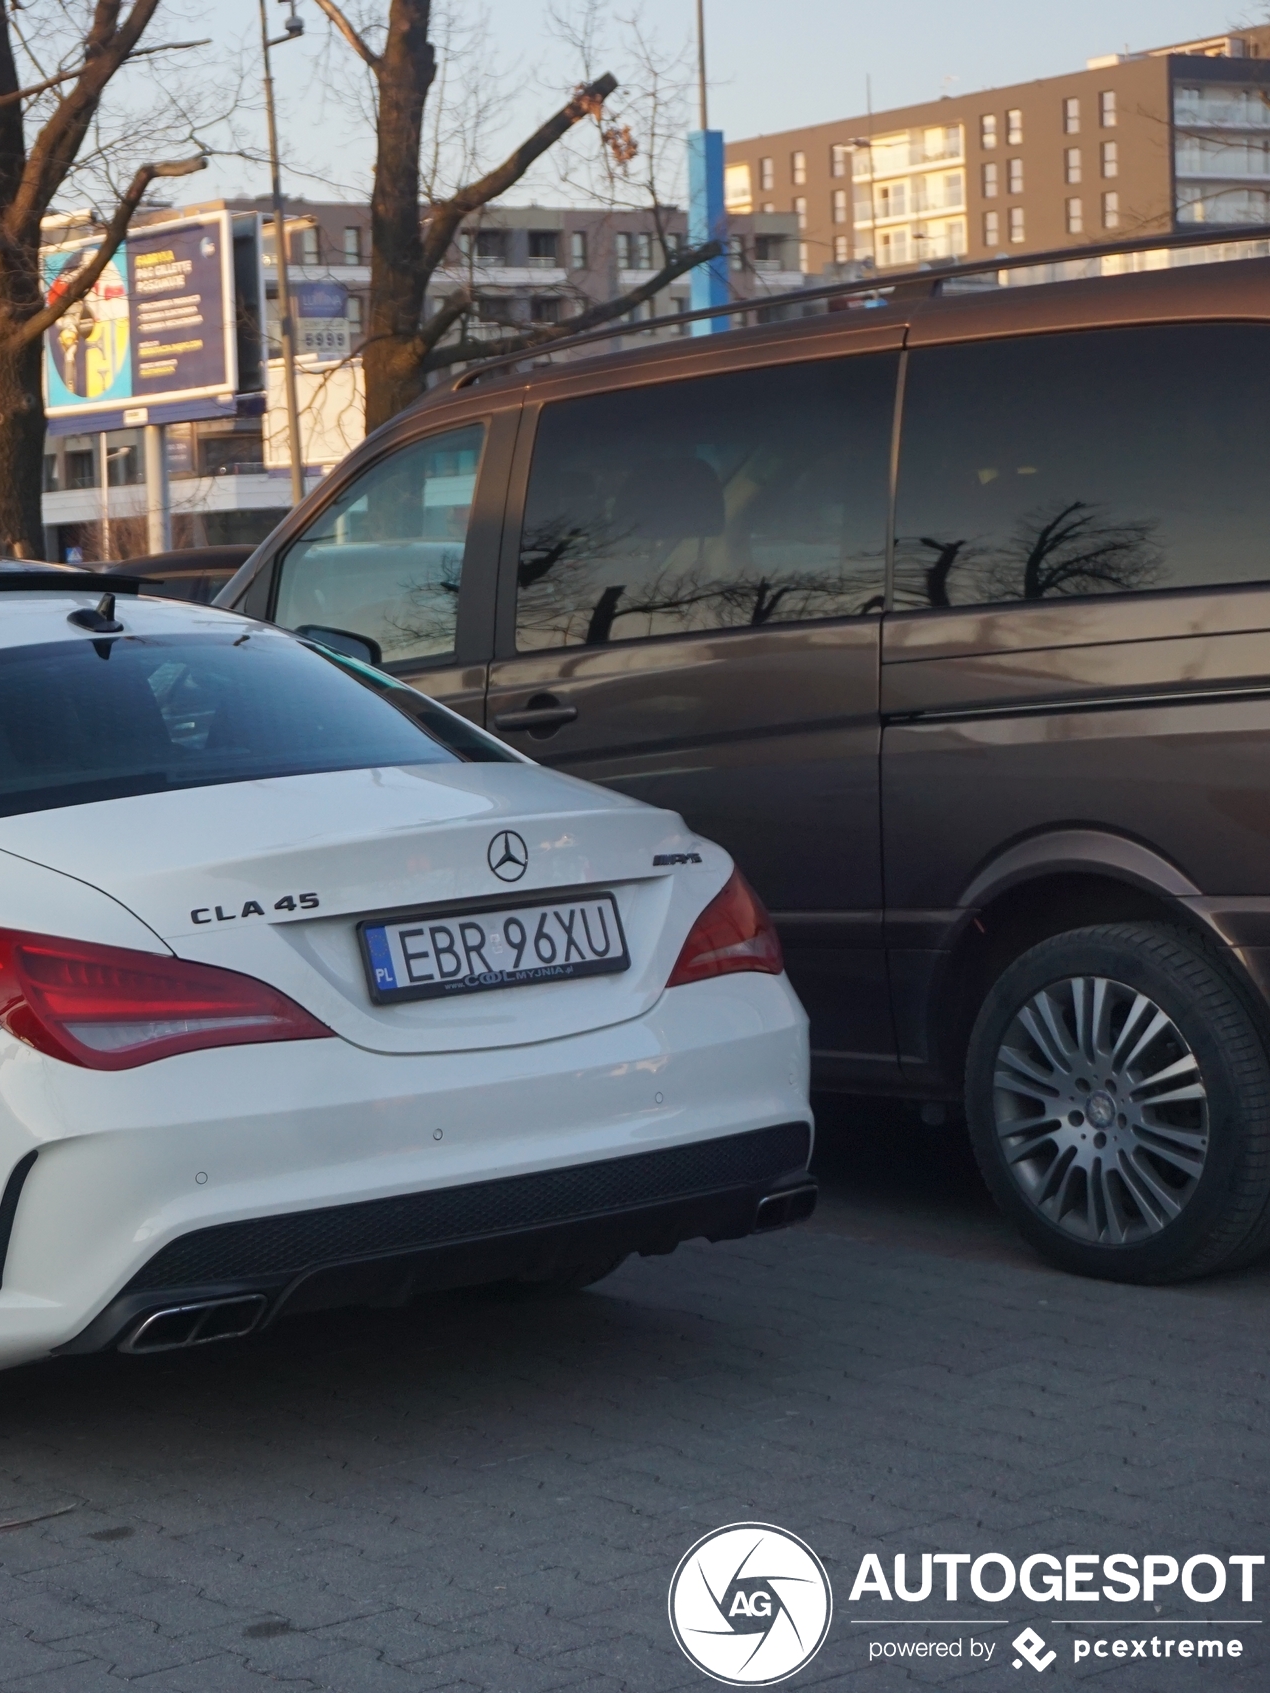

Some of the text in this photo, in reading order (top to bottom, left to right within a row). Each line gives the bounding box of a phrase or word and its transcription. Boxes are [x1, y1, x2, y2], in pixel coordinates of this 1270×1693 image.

[190, 892, 320, 925] CLA 45
[398, 906, 611, 983] EBR 96XU
[375, 968, 393, 983] PL
